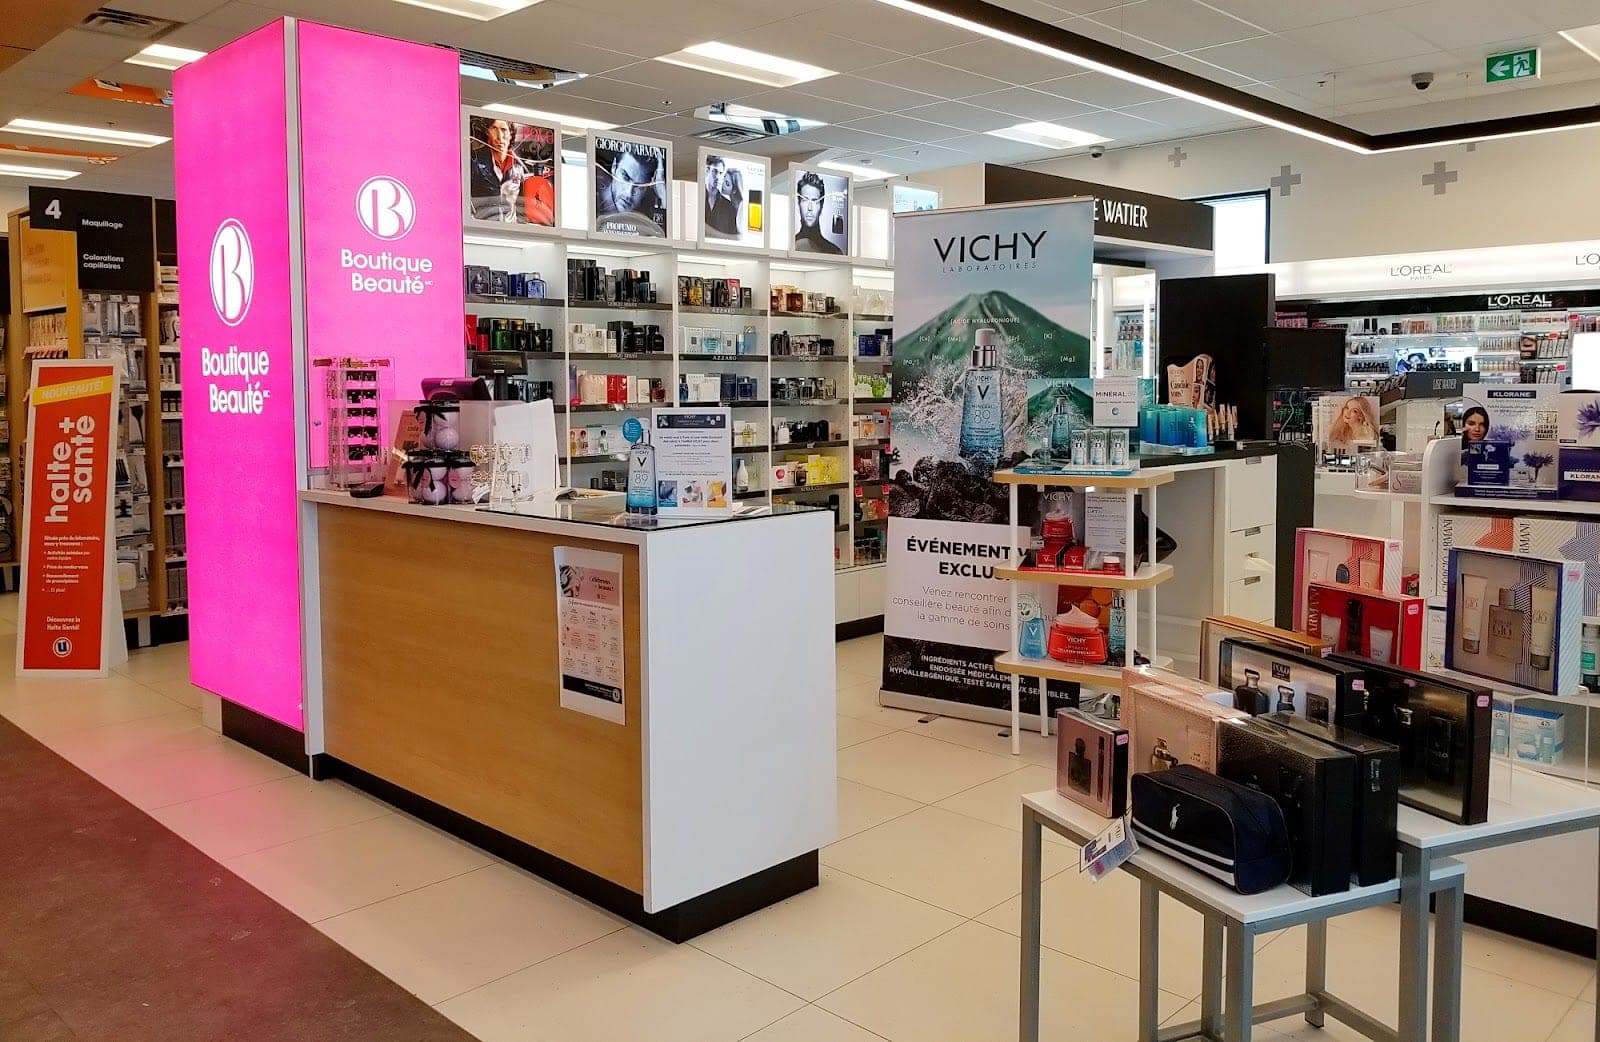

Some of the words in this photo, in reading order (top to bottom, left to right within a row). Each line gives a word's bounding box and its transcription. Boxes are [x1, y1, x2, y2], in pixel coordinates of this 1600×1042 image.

[595, 138, 631, 153] GIORGIO
[634, 144, 666, 160] ARMANI
[45, 199, 62, 219] 4
[1103, 199, 1148, 228] WATIER
[81, 219, 124, 229] Maquillage
[933, 230, 1048, 264] VICHY
[82, 253, 125, 263] Colorations
[82, 262, 122, 270] capillaires
[341, 248, 433, 274] Boutique
[942, 262, 1037, 274] LABORATOIRES
[1390, 264, 1453, 277] L'ORÉAL
[351, 273, 425, 295] Beauté
[1487, 294, 1553, 307] L'ORÉAL
[201, 347, 270, 383] Boutique
[41, 381, 104, 399] NOUVEAUTÉ!
[209, 382, 264, 414] Beauté
[977, 385, 990, 400] V
[1095, 390, 1127, 398] MINÉRAL
[44, 441, 73, 523] halte
[1043, 492, 1073, 502] VICHY
[906, 536, 1011, 560] ÉVÉNEMENT
[922, 586, 952, 598] Venez
[954, 590, 1009, 604] rencontrer
[892, 596, 943, 610] conseillère
[945, 600, 980, 615] beauté
[982, 605, 1002, 618] afin
[917, 610, 926, 620] la
[928, 614, 965, 628] gamme
[967, 616, 978, 627] de
[983, 619, 1010, 631] soins
[1066, 635, 1087, 643] VICHY
[921, 654, 967, 667] INGRÉDIENTS
[968, 661, 994, 672] ACTIFS
[929, 664, 967, 677] ENDOSSÉE
[963, 676, 985, 688] TESTÉ
[986, 680, 1001, 689] SUR
[1002, 683, 1028, 694] PEUX
